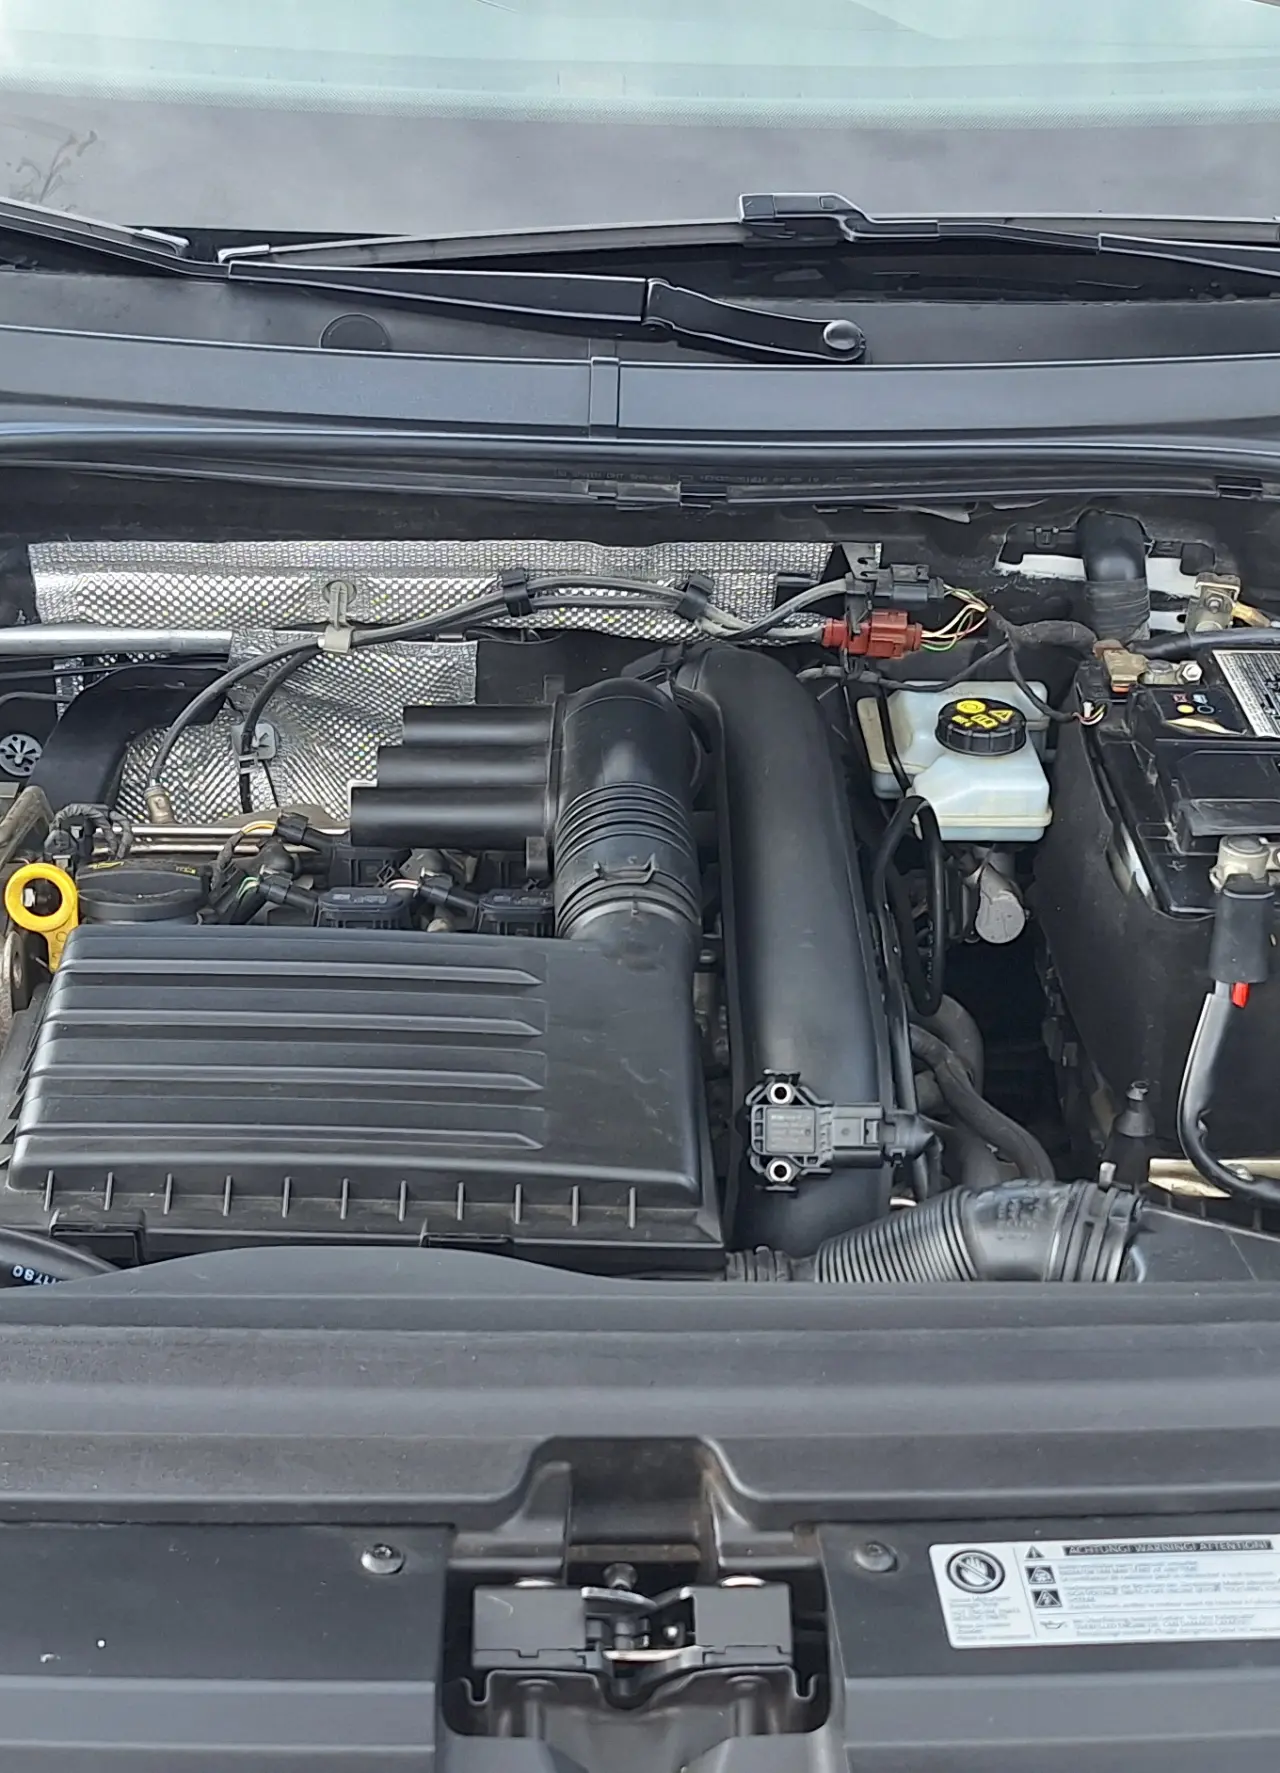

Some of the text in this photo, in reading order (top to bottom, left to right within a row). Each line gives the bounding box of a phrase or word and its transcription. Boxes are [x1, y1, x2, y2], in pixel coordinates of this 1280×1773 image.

[1069, 1540, 1268, 1555] ACHTUNG! WARNING! ATTENTION!
